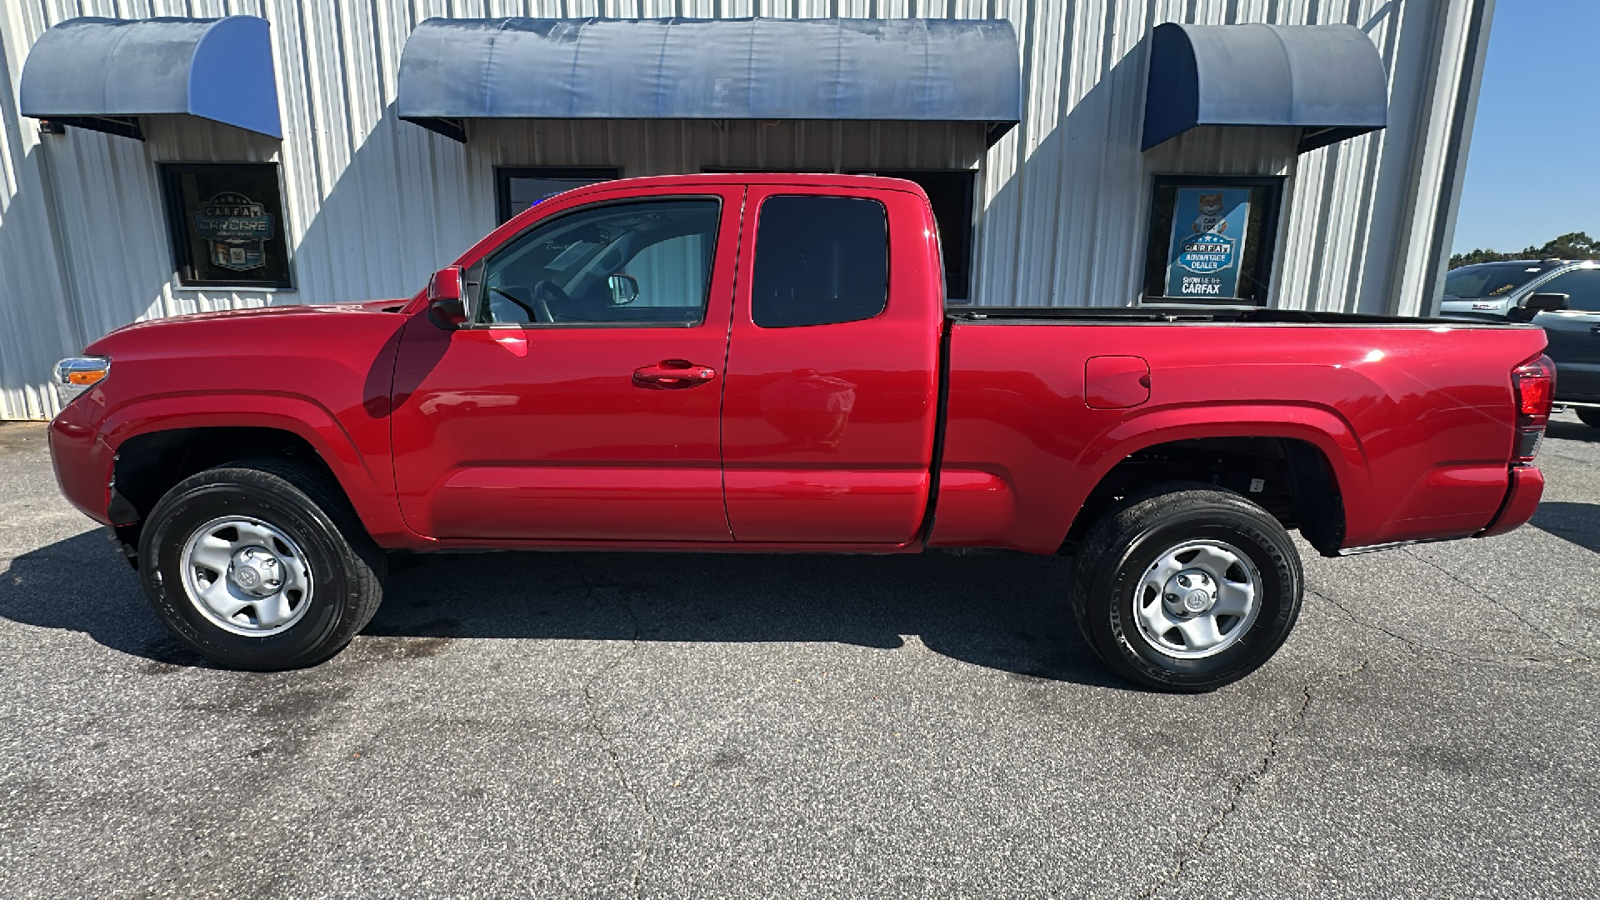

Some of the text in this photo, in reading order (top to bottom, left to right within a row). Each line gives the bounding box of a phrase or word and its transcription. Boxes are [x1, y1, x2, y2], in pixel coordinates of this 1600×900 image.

[205, 207, 260, 217] CARFAX
[1184, 244, 1230, 253] CARFAX
[1185, 254, 1226, 262] ADVANTAGE
[1191, 261, 1218, 269] DEALER
[1181, 283, 1221, 294] CARFAX
